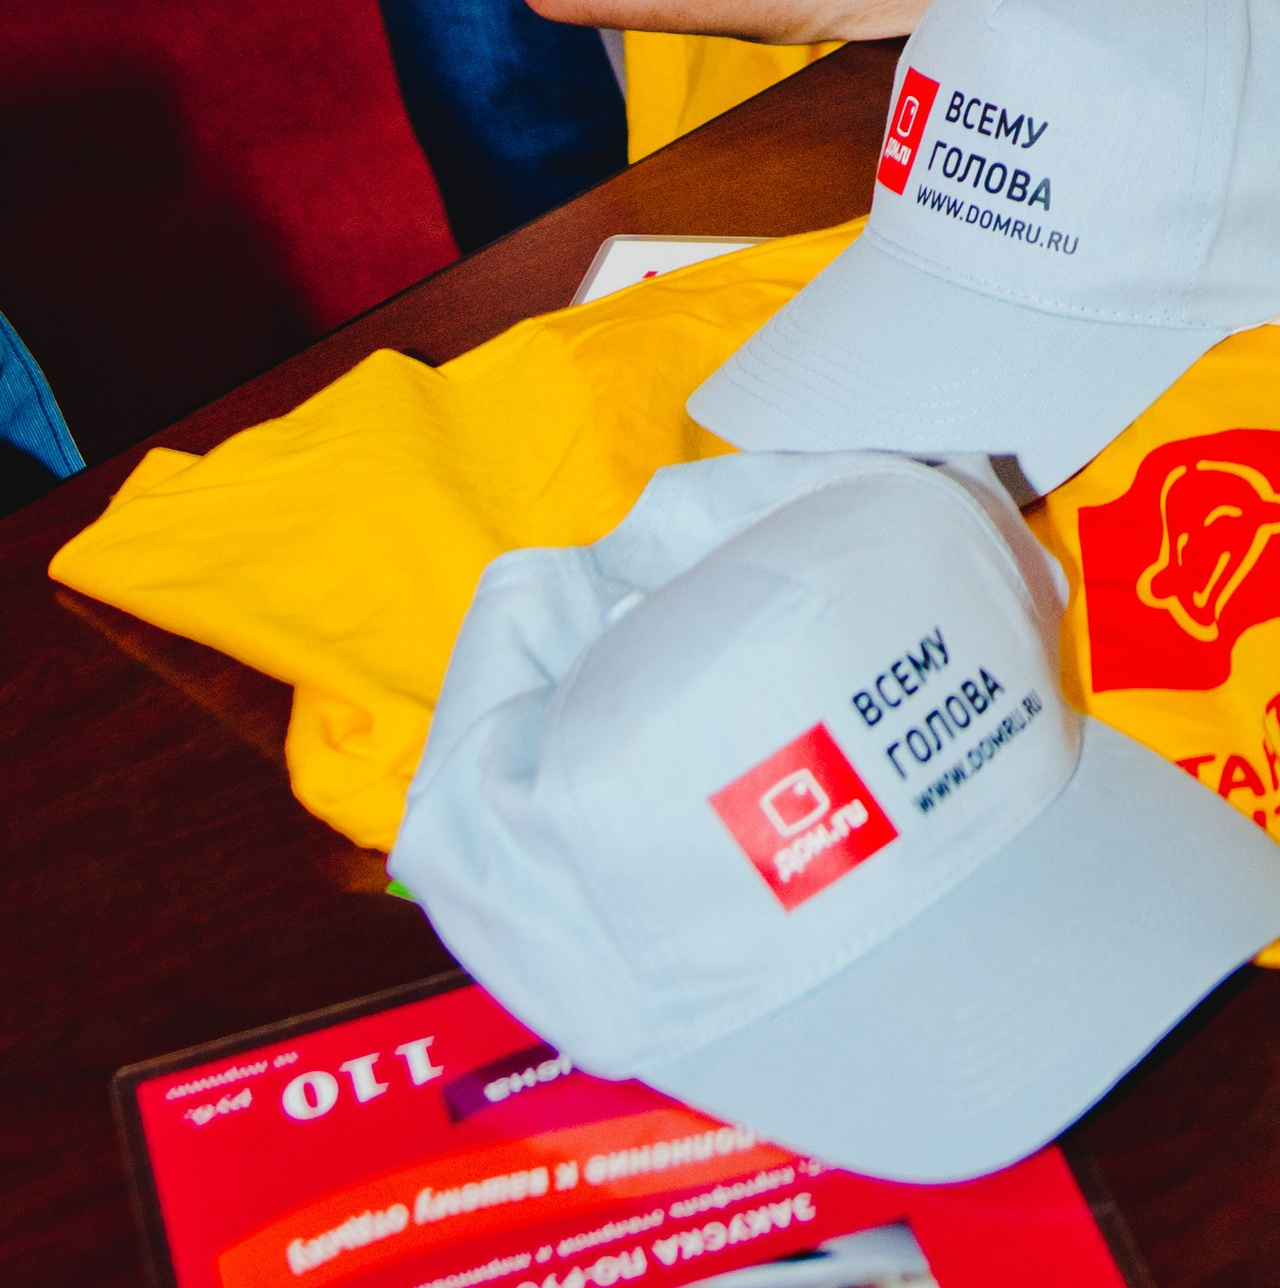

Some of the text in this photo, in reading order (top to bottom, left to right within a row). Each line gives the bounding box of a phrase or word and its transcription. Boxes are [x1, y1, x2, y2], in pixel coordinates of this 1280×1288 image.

[945, 90, 1049, 149] ВСЕМУ
[928, 140, 1051, 211] ГОЛОВА
[916, 184, 1080, 255] WWW.DOMRU.RU
[852, 625, 950, 726] ВСЕМУ
[886, 667, 1005, 781] ГОЛОВА
[282, 1035, 445, 1121] 110
[584, 1127, 756, 1186] полнение
[651, 1192, 817, 1266] ЗАКУСКА
